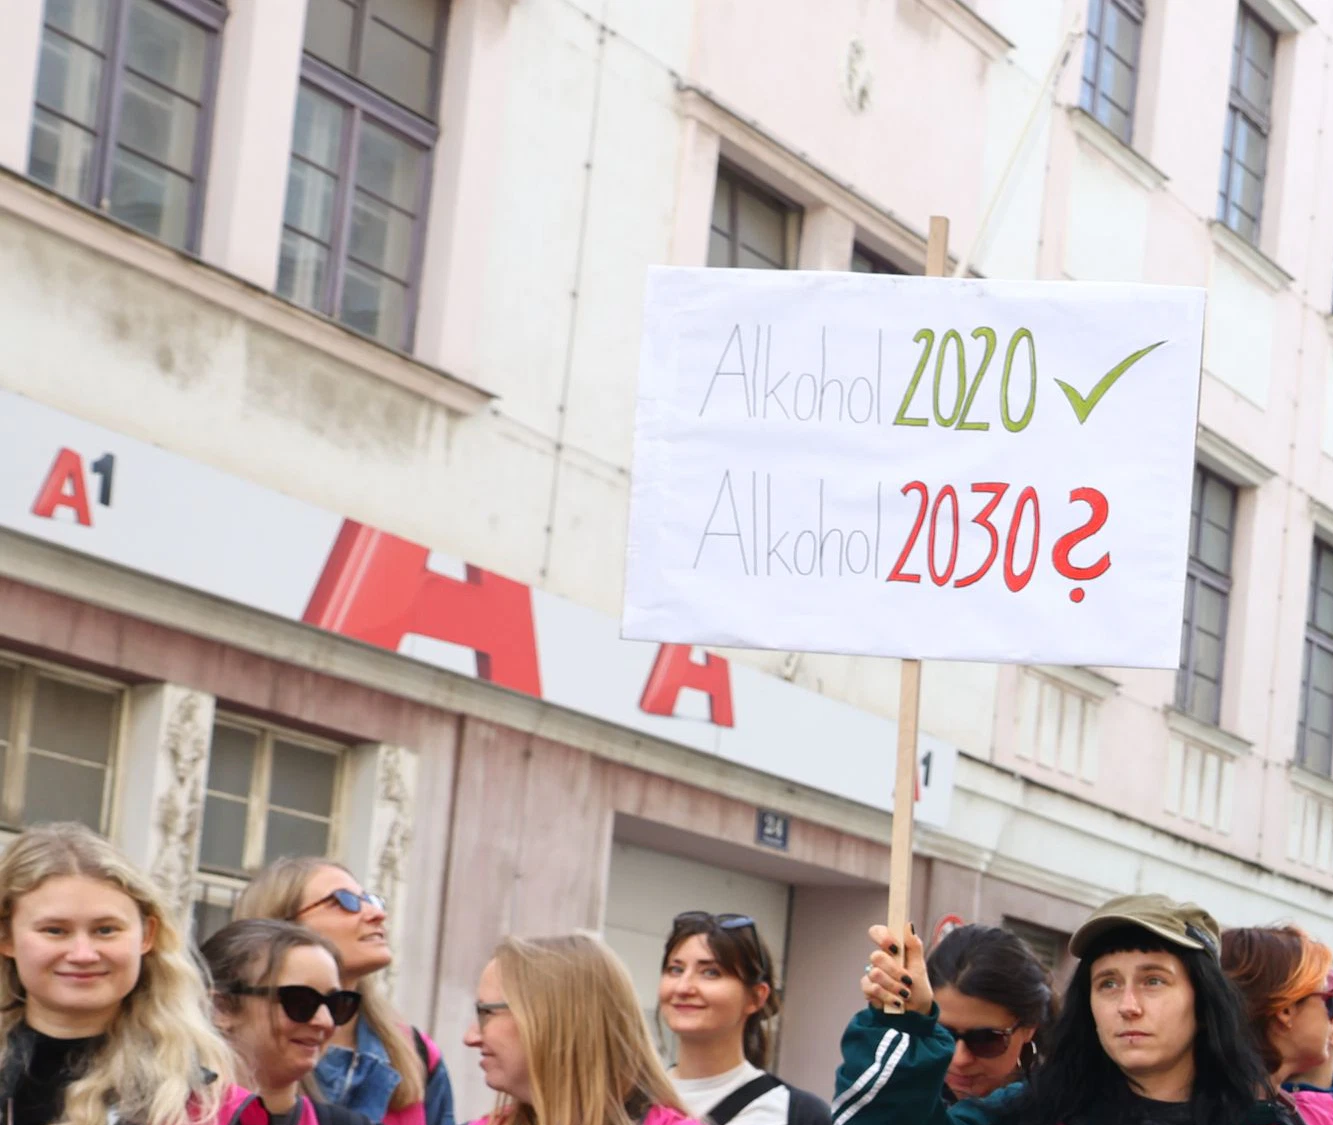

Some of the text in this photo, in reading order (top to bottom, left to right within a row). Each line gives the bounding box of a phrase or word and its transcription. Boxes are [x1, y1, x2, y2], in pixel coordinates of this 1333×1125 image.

[696, 322, 1038, 433] Alkohol 2020
[31, 446, 117, 528] A1
[692, 468, 882, 580] Alkohol
